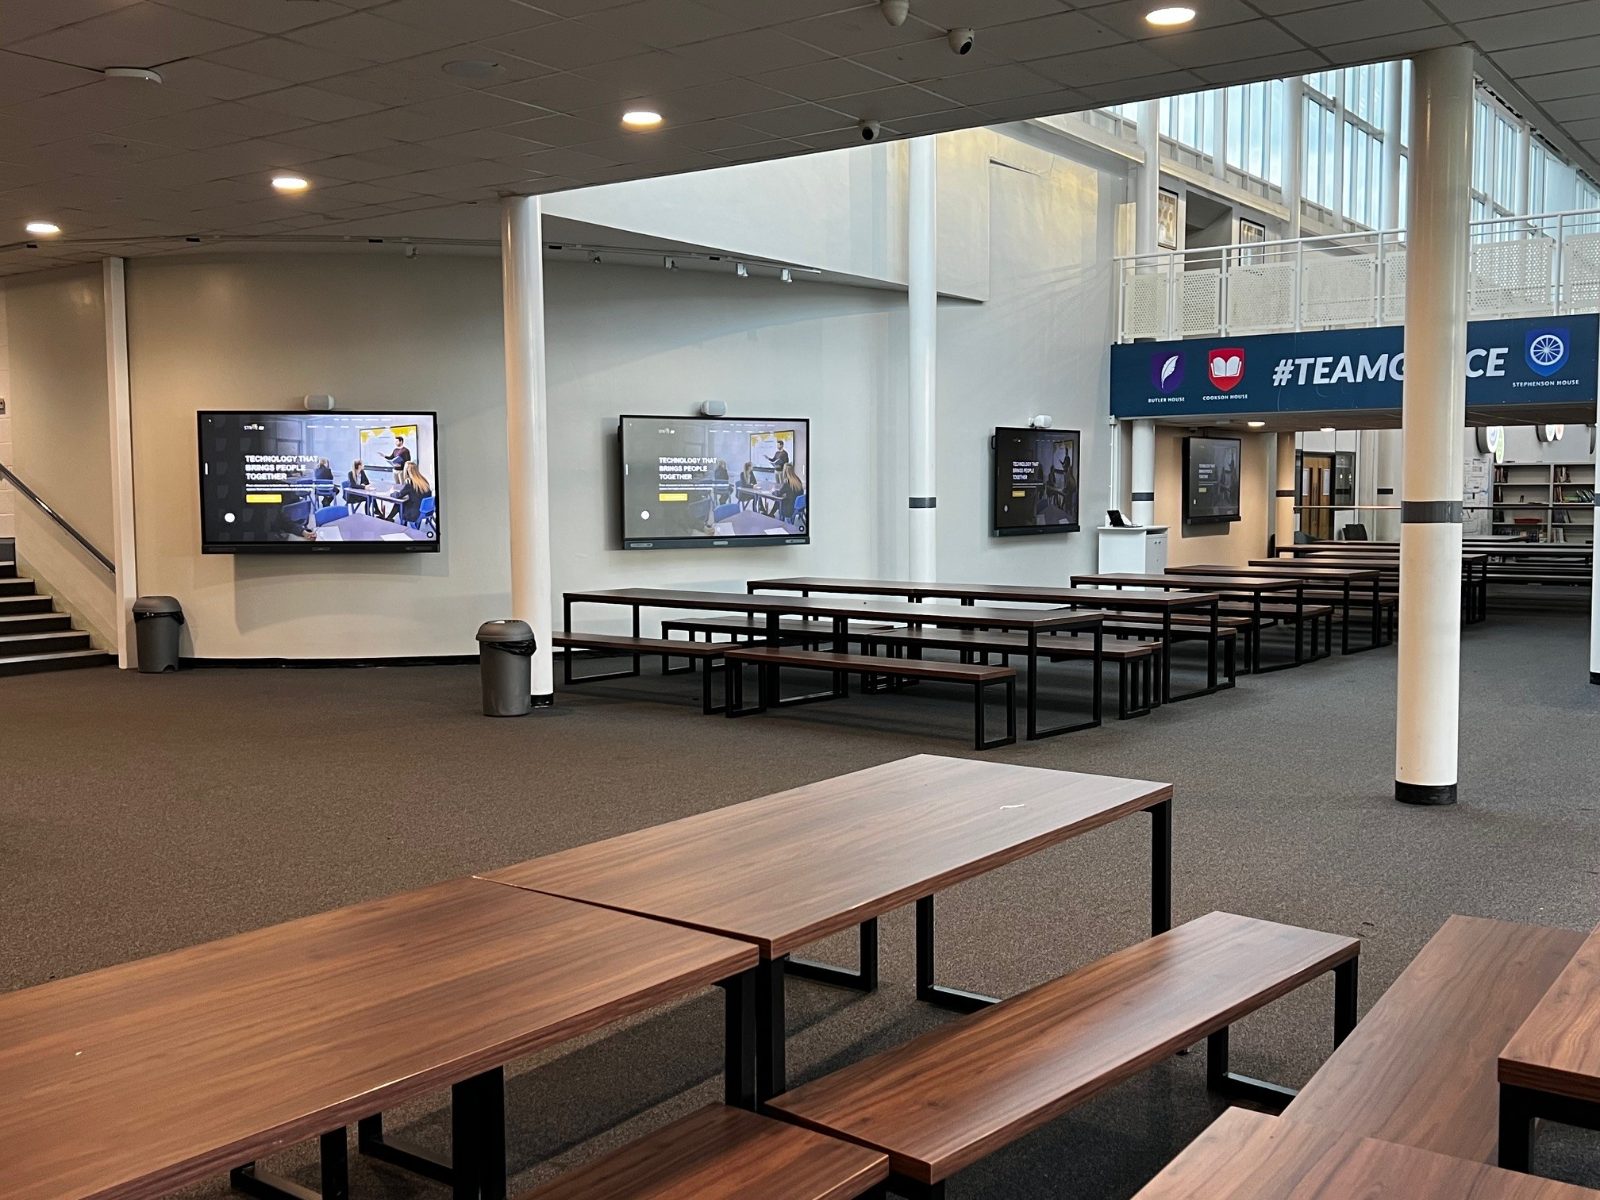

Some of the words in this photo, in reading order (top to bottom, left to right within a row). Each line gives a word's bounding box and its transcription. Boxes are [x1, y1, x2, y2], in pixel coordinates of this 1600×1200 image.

[1273, 347, 1508, 387] #TEAMGCE
[1512, 380, 1555, 388] STEPHENSON
[245, 455, 299, 463] TECHNOLOGY
[299, 455, 318, 463] THAT
